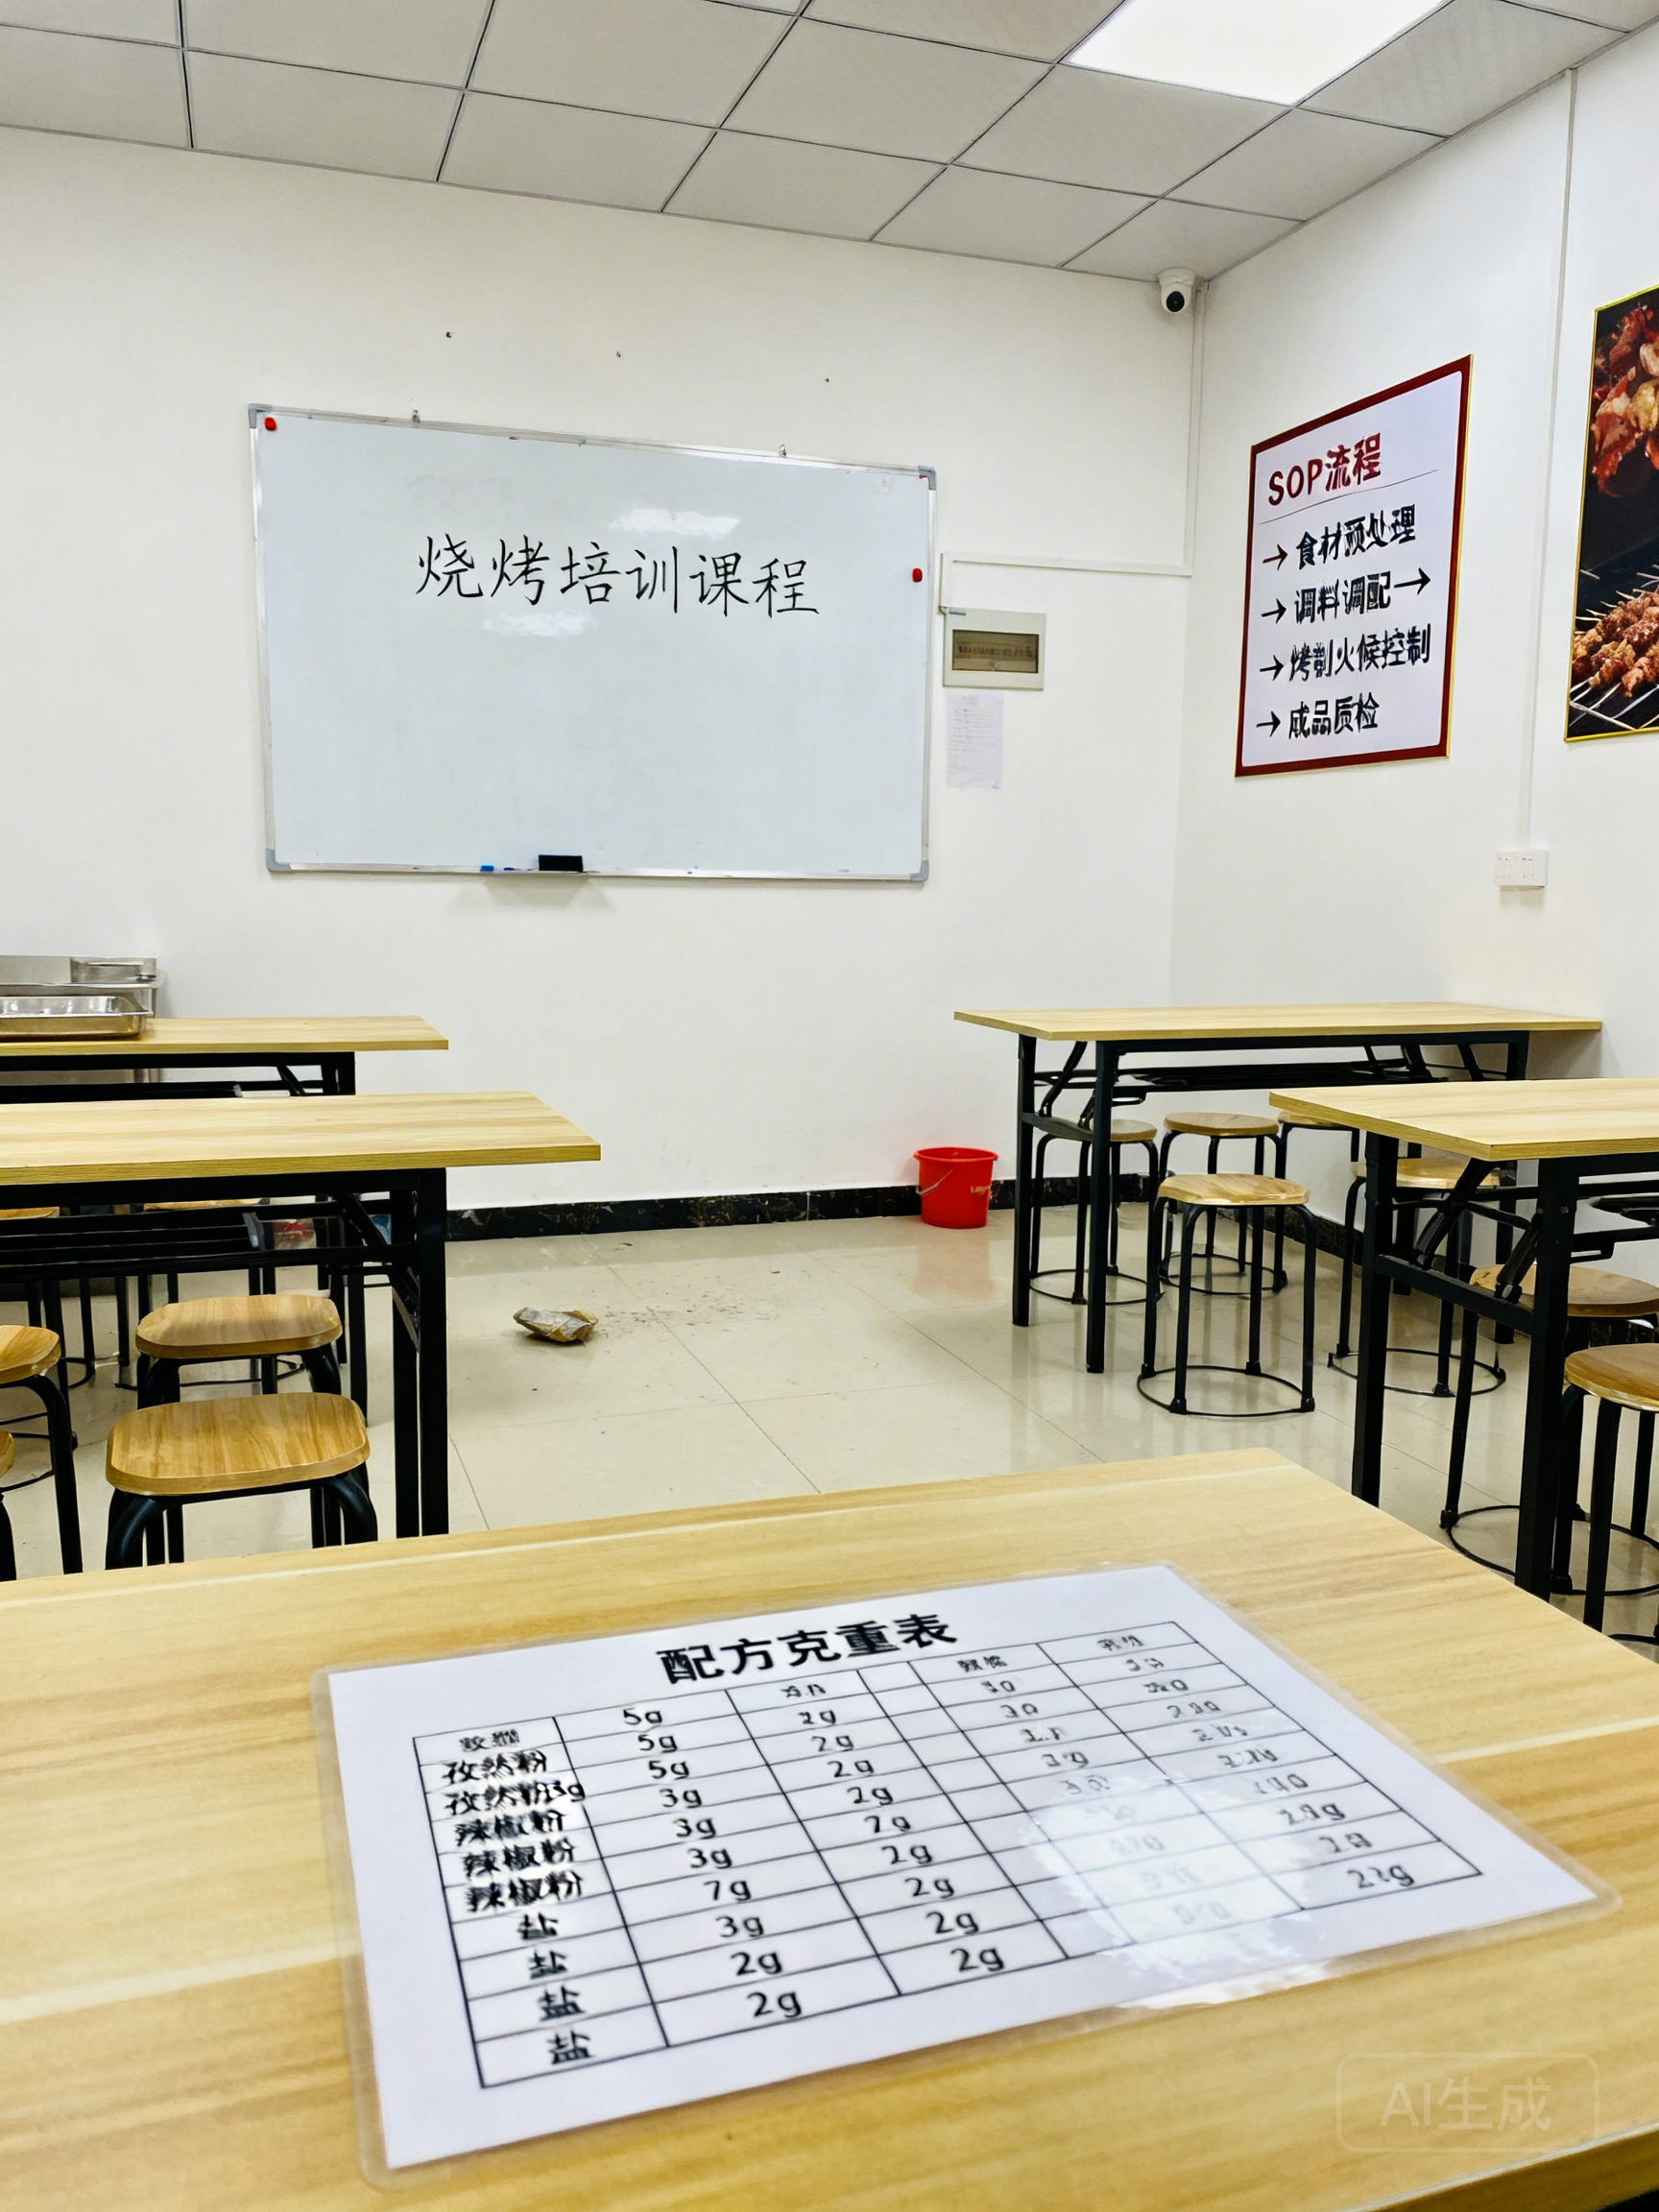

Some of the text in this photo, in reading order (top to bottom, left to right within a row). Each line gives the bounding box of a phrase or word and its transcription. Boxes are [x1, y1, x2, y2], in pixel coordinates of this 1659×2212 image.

[1268, 432, 1382, 506] SOP流程
[1296, 503, 1416, 570] 食材预处理
[415, 534, 820, 618] 烧烤培训课程
[1294, 570, 1391, 624] 调料调配
[1288, 691, 1380, 739] 成品质检
[656, 1614, 958, 1685] 配方克重表
[637, 1734, 678, 1754] 5g
[648, 1760, 689, 1781] 5g
[659, 1788, 703, 1810] 3g
[673, 1817, 717, 1839] 3g
[847, 1786, 894, 1806] 2g
[517, 1844, 932, 1940] 盐 7g 2g
[687, 1847, 733, 1870] 3g
[528, 1949, 567, 1980] 盐
[715, 1916, 764, 1938] 3g
[904, 1877, 955, 1899] 2g
[538, 1985, 586, 2022] 盐
[731, 1951, 783, 1976] 2g
[926, 1911, 979, 1936] 2g
[547, 2031, 594, 2064] 盐
[747, 1991, 802, 2019] 2g
[950, 1947, 1005, 1972] 2g
